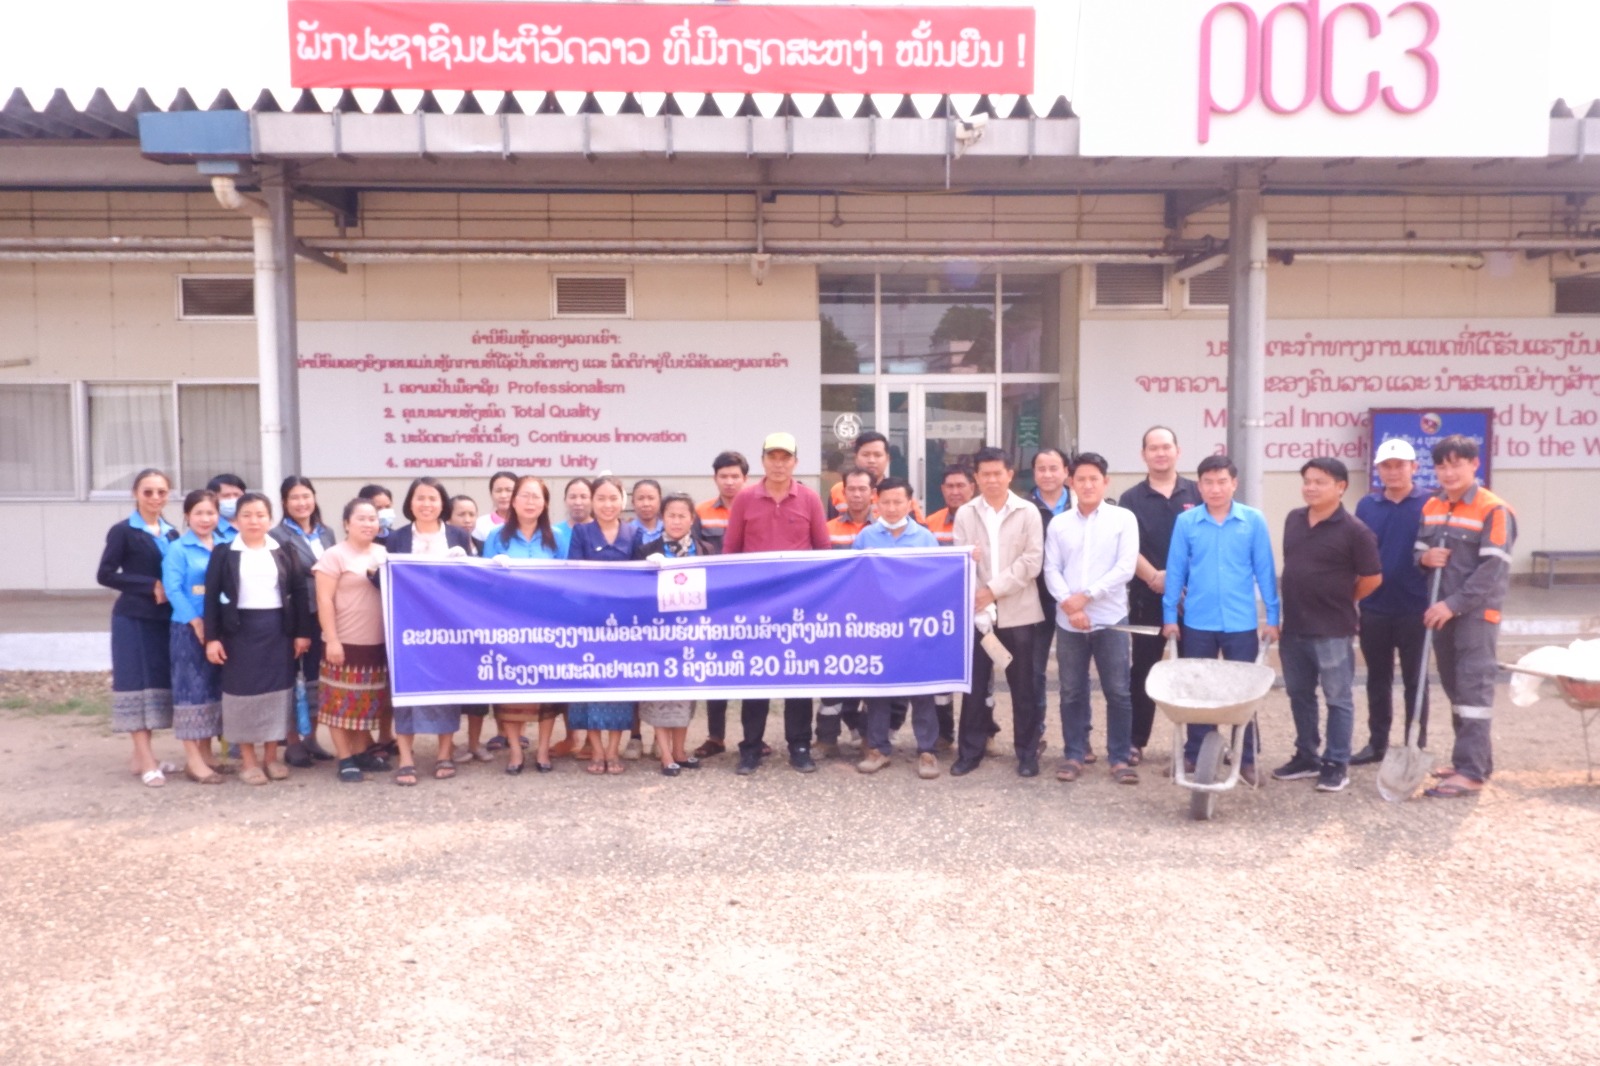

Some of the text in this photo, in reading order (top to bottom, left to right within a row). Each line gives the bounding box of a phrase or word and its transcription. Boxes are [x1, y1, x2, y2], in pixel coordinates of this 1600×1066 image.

[508, 379, 625, 394] Professionalism
[512, 403, 545, 418] Total
[549, 403, 601, 420] Quality
[1204, 406, 1294, 428] Mcal
[1301, 408, 1370, 428] Innova
[1520, 404, 1548, 433] by
[1556, 406, 1598, 426] Lao
[529, 429, 611, 443] Continuous
[615, 427, 687, 443] Innovation
[1508, 437, 1530, 457] to
[1539, 434, 1575, 457] the
[561, 455, 598, 469] Unity
[909, 616, 939, 638] 70
[942, 609, 955, 636] ປີ
[663, 656, 679, 678] 3
[750, 655, 780, 676] 20
[823, 654, 884, 676] 2025
